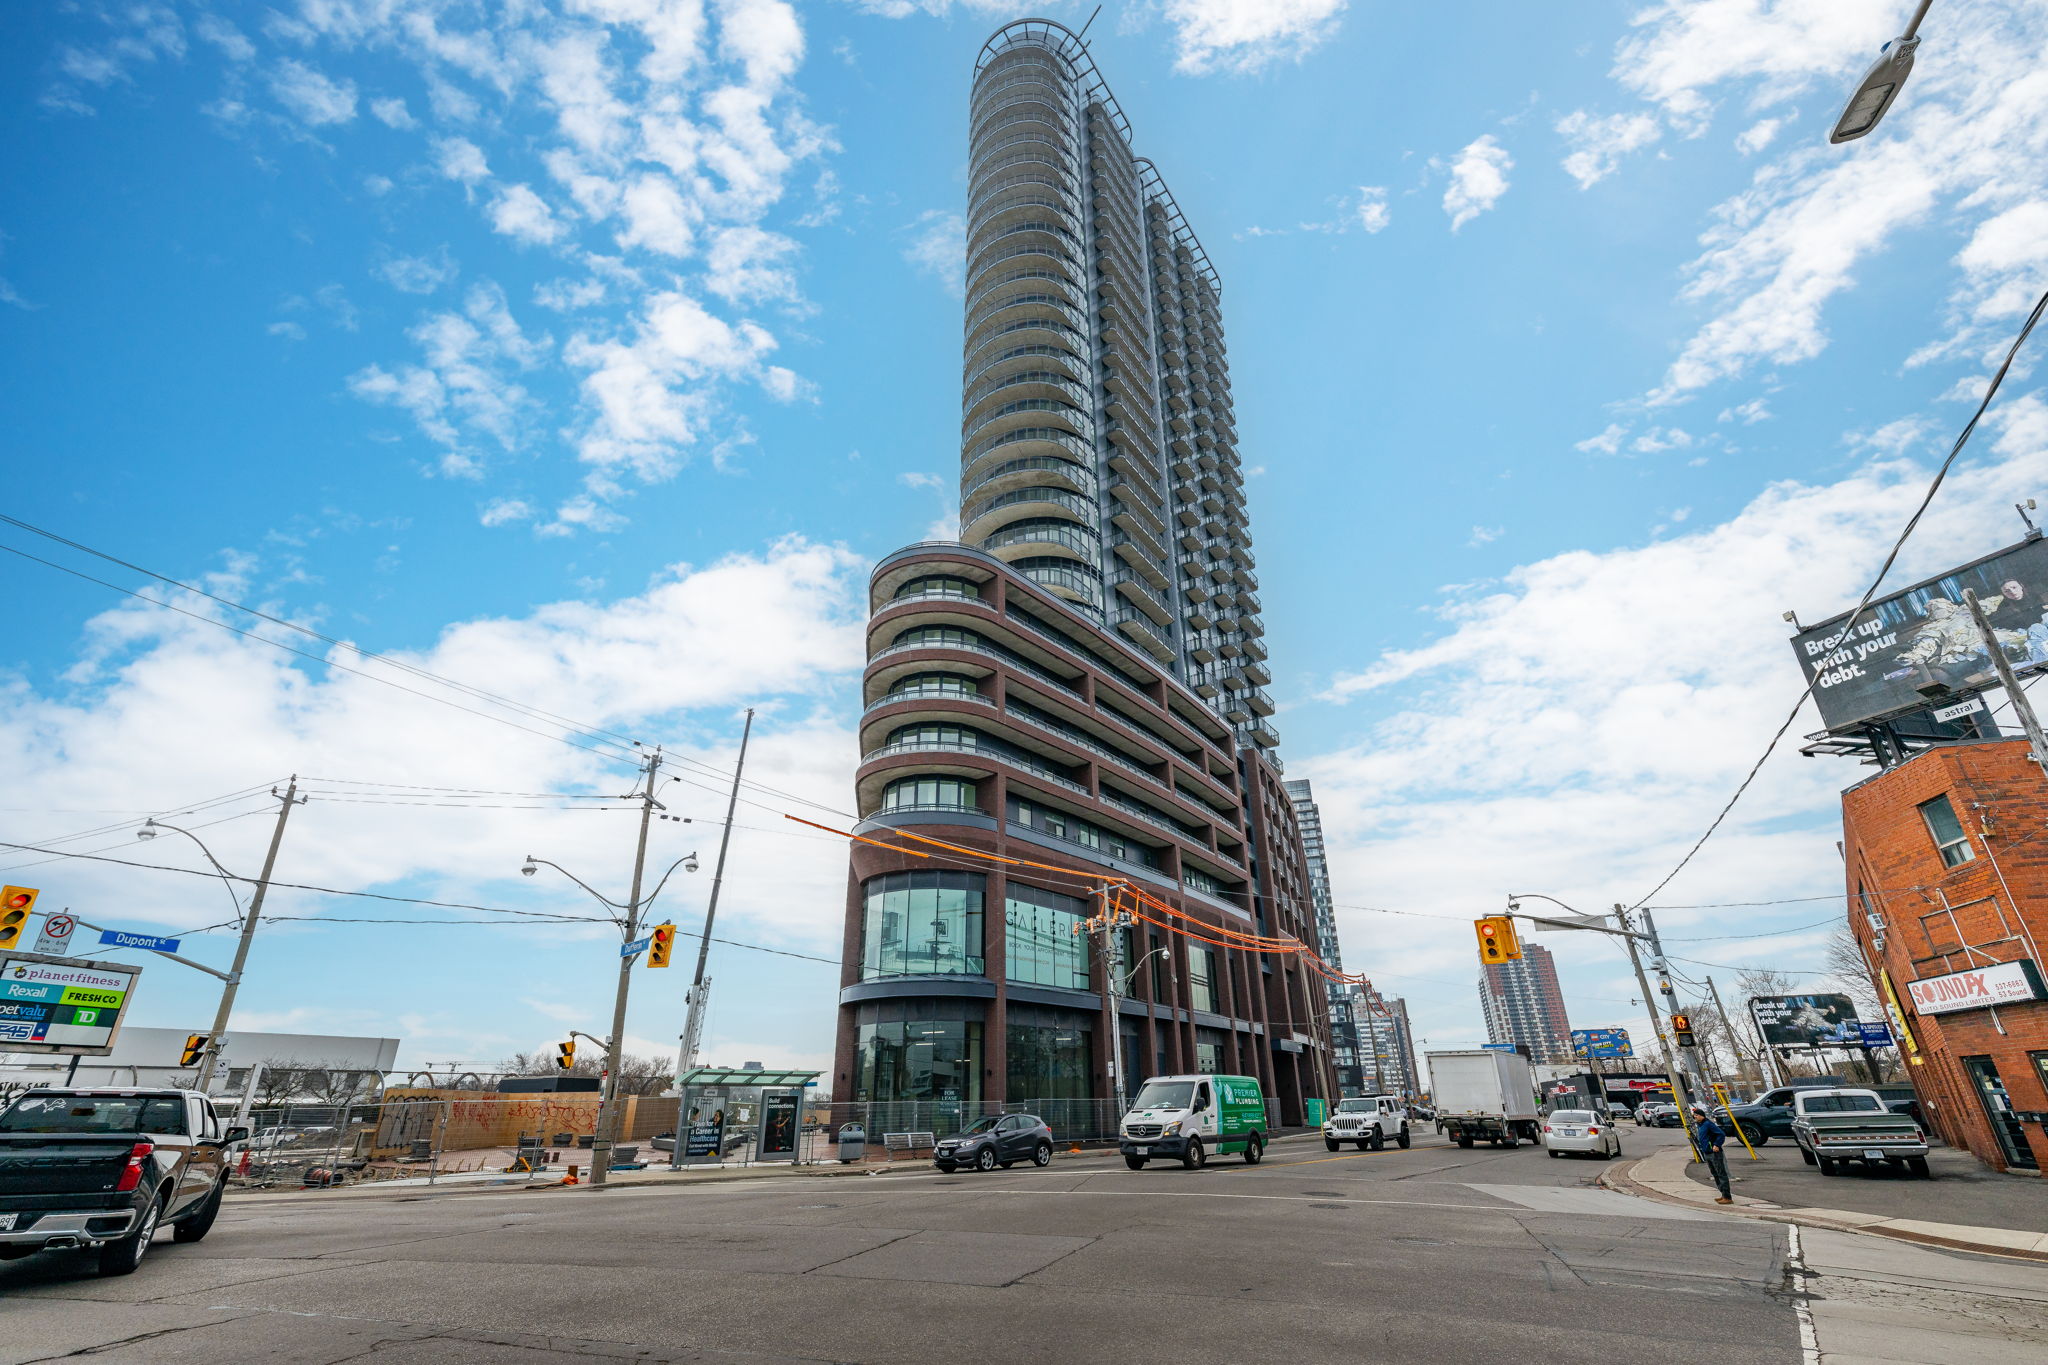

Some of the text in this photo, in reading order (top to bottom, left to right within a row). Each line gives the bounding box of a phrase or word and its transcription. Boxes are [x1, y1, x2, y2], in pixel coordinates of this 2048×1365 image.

[1805, 619, 1883, 656] Break up
[1811, 632, 1897, 672] with your
[1819, 663, 1866, 688] debt.
[1945, 703, 1974, 718] astral
[116, 933, 157, 948] Dupont
[8, 984, 48, 998] Rexall
[2007, 988, 2028, 997] Sound
[1776, 1002, 1787, 1010] up
[1920, 996, 1996, 1013] AUTO SOUND LIMITED
[79, 1011, 96, 1023] TD
[1776, 1010, 1792, 1018] your
